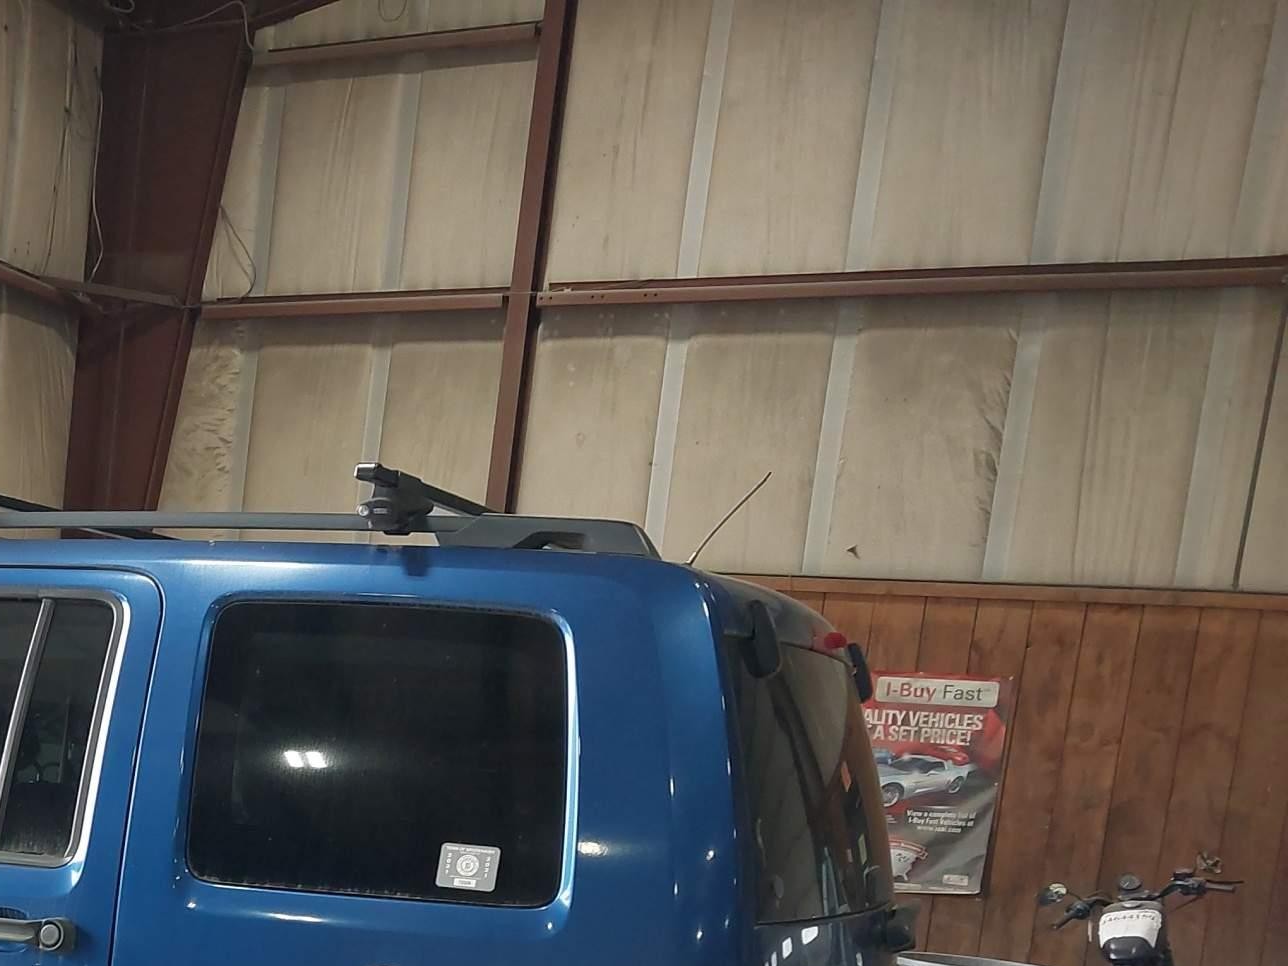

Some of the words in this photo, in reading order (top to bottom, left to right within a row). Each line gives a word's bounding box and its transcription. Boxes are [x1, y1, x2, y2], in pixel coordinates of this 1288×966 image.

[885, 681, 936, 702] I-Buy
[909, 711, 983, 731] VEHICLES
[873, 725, 884, 740] A
[889, 725, 919, 742] SET
[920, 728, 972, 746] PRICE!
